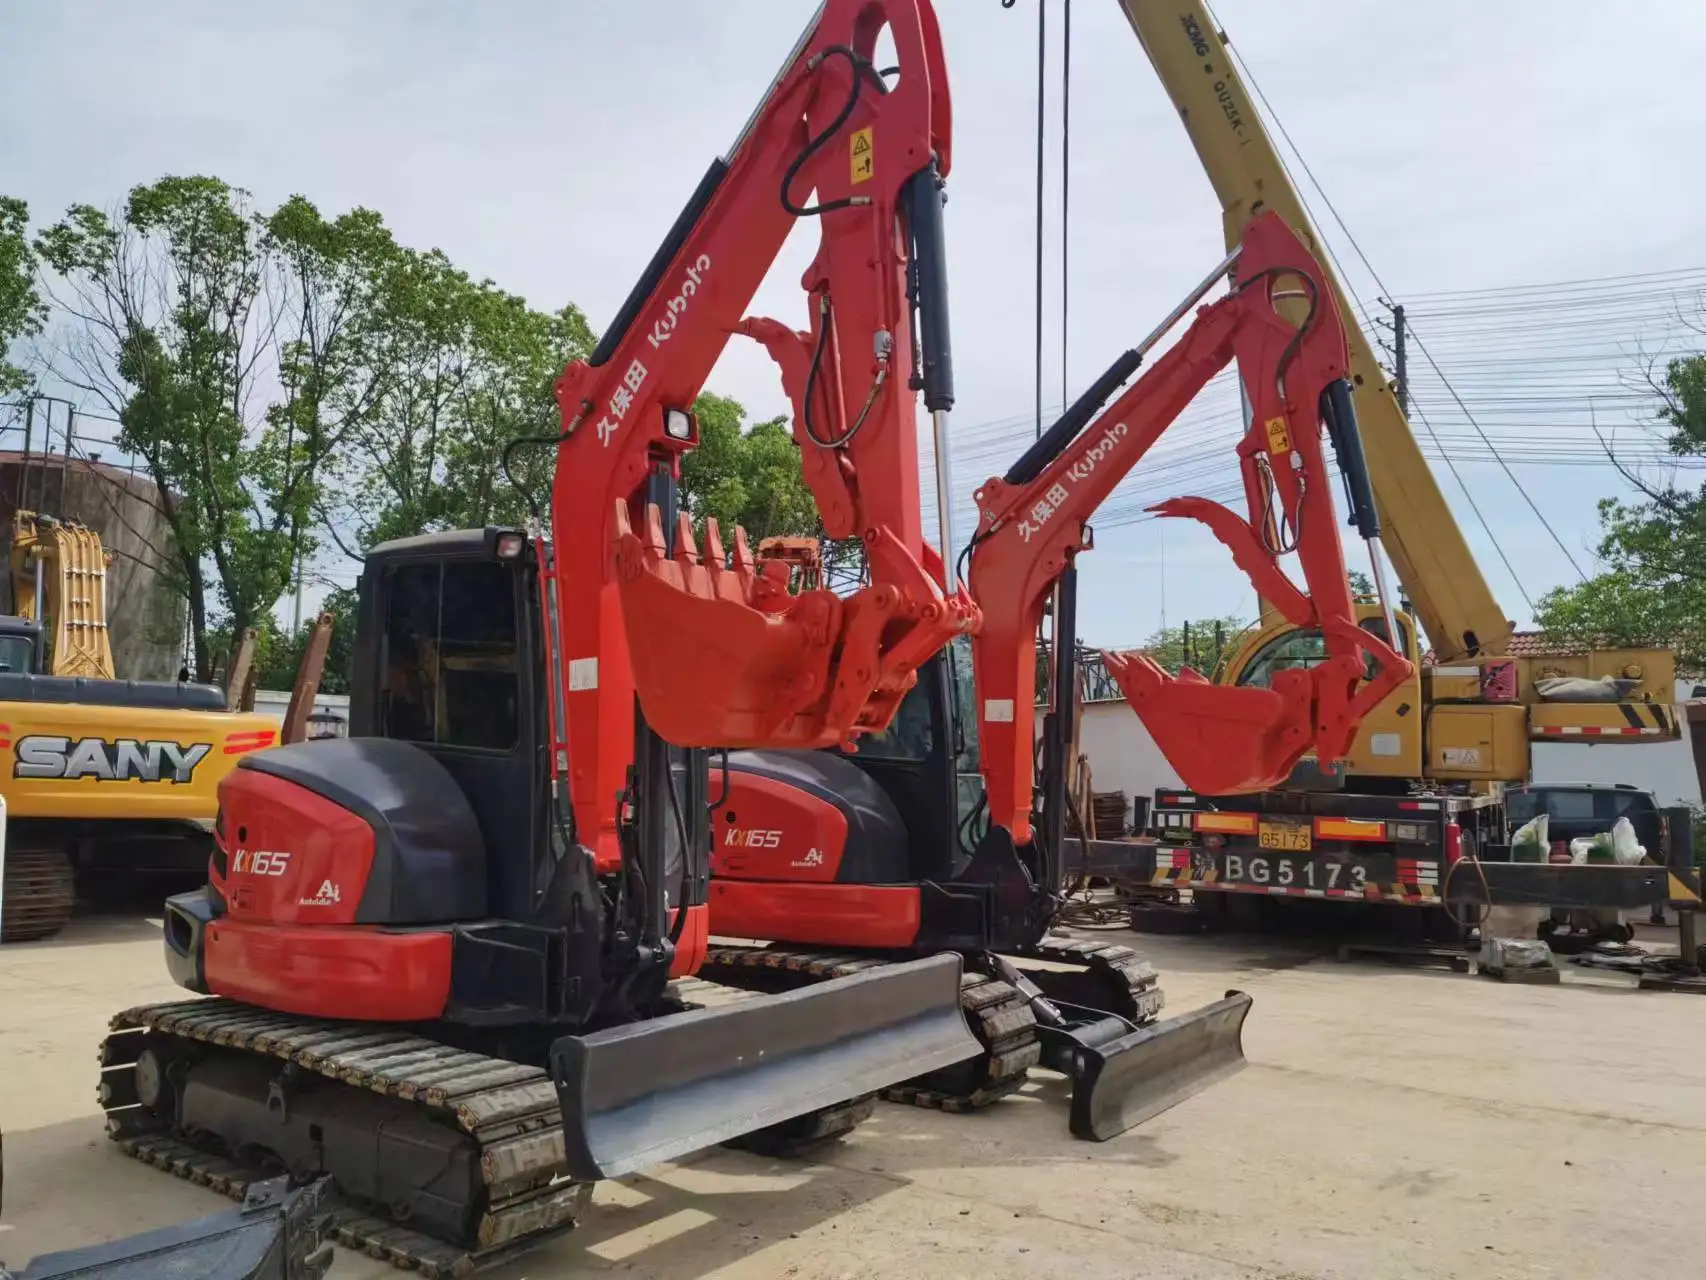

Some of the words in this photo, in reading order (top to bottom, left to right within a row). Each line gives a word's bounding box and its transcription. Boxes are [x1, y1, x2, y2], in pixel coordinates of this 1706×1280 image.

[1180, 13, 1210, 57] XCMG
[596, 357, 648, 448] 久保田
[647, 253, 711, 349] Kubota
[1017, 482, 1069, 543] 久保田
[1066, 422, 1128, 482] Kubota
[13, 735, 213, 784] SANY
[724, 828, 783, 848] KX165
[233, 849, 291, 876] KX165
